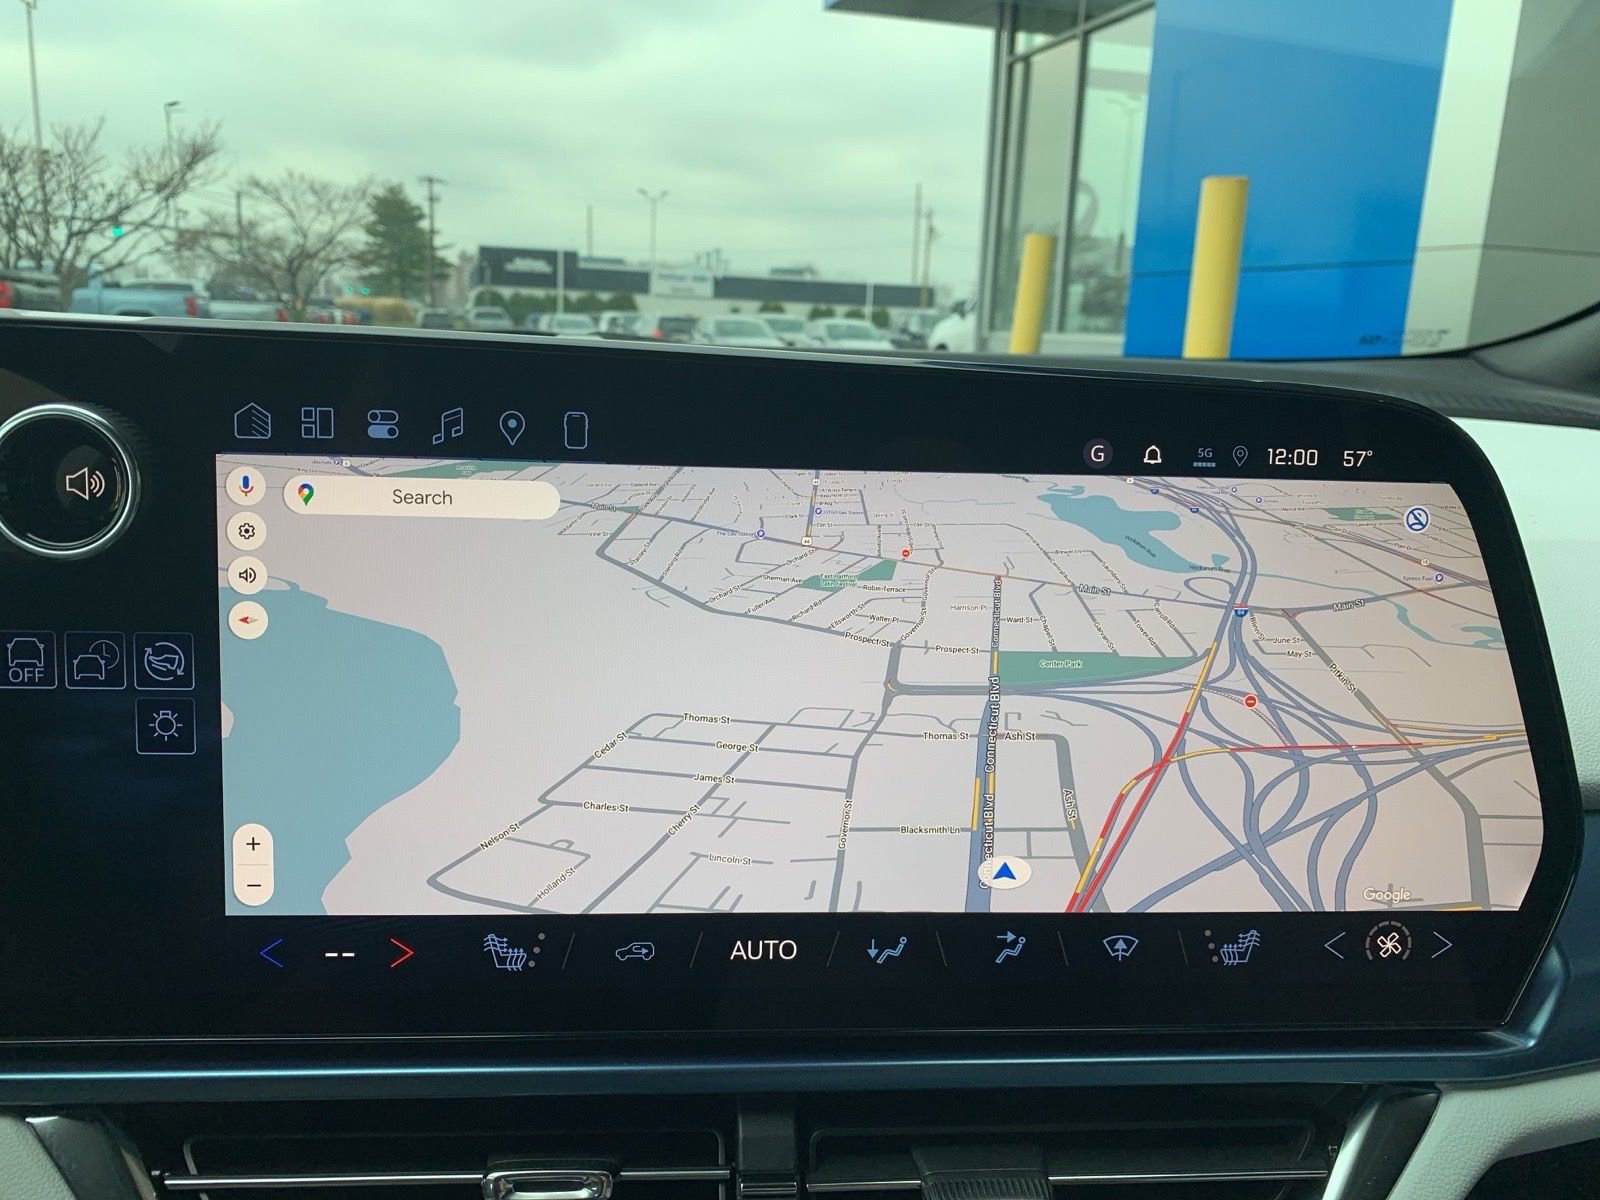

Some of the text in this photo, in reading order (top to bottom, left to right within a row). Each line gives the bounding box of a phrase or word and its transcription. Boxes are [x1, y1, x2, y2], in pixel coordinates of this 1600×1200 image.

[1091, 445, 1105, 462] G
[1198, 448, 1213, 458] 5G
[1267, 448, 1318, 466] 12:00
[1343, 450, 1373, 468] 57°
[392, 489, 453, 505] Search
[592, 502, 608, 511] Main
[786, 553, 808, 566] Orchard
[763, 575, 790, 583] Sherman
[709, 588, 733, 603] Orchard
[1079, 584, 1111, 596] Main St
[747, 596, 776, 614] Fuller Ave
[791, 605, 814, 621] Richard
[1153, 602, 1169, 622] Carroll
[1333, 599, 1365, 612] Main St
[831, 609, 858, 629] Ellsworth
[869, 614, 891, 622] Walter
[992, 580, 1001, 647] Connecticut Blvd
[901, 616, 926, 641] Governor
[1040, 615, 1052, 636] Chapel
[1094, 621, 1110, 642] Garvan
[1134, 620, 1150, 640] Tower
[1251, 616, 1261, 635] Blinn
[845, 632, 890, 647] Prospect St
[935, 645, 969, 655] Prospect
[1287, 651, 1300, 659] May
[1040, 660, 1083, 668] Center Park
[8, 668, 44, 683] OFF
[1329, 663, 1357, 695] Pitkin St
[683, 713, 731, 724] Thomas St
[985, 676, 1000, 773] Connecticut Blvd
[923, 732, 969, 740] Thomas St
[1004, 732, 1036, 741] Ash St
[594, 731, 627, 759] Cedar St
[716, 741, 759, 753] George St
[694, 773, 735, 784] James St
[583, 801, 629, 812] Charles St
[983, 794, 995, 819] Blvd
[1063, 789, 1076, 820] Ash St
[668, 804, 701, 836] Cherry St
[838, 799, 853, 849] Governor St
[480, 822, 520, 851] Nelson St
[900, 826, 960, 834] Blacksmith Ln
[709, 853, 752, 865] Lincoln St
[537, 867, 576, 900] Holland St
[1363, 887, 1411, 903] Google
[730, 940, 797, 960] AUTO
